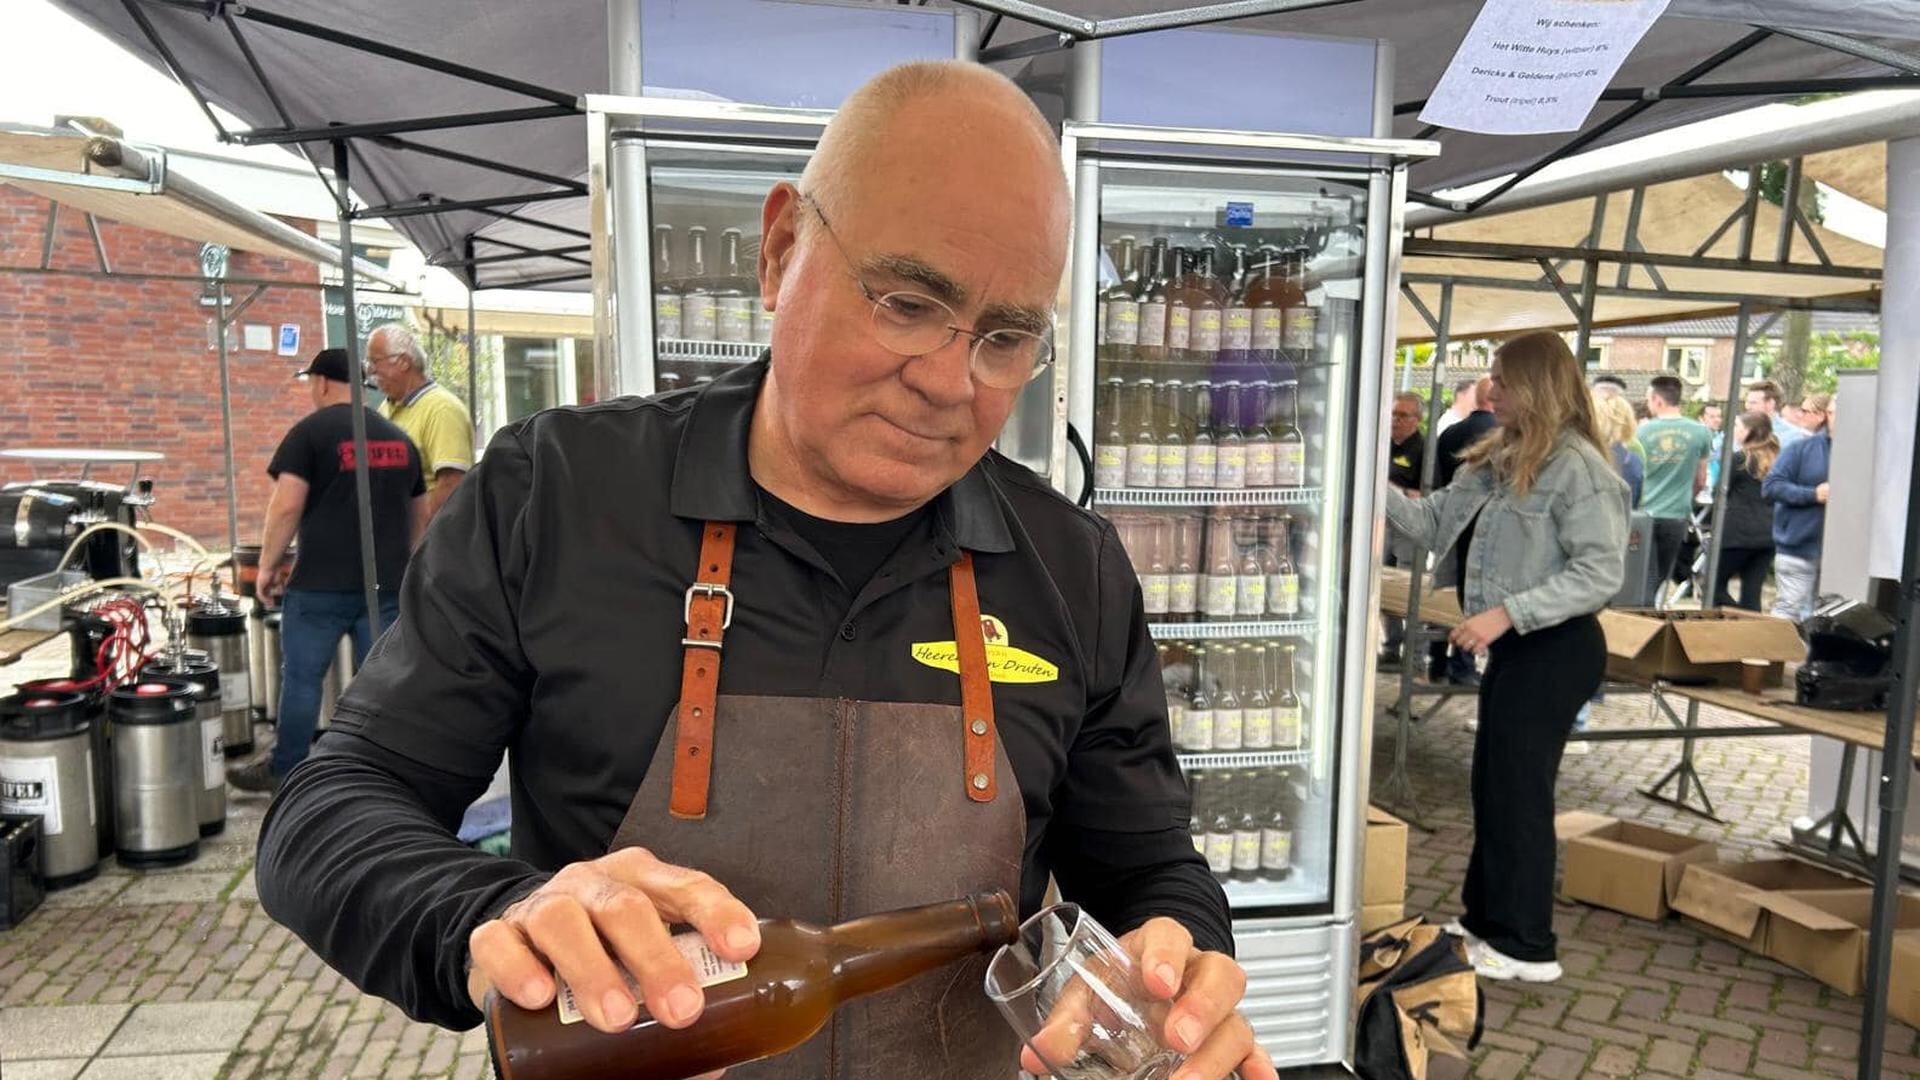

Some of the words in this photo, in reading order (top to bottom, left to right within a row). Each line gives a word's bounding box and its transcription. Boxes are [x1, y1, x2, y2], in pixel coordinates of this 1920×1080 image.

[1537, 18, 1551, 28] Wij
[1492, 41, 1509, 51] Het
[1511, 42, 1534, 52] Witte
[1536, 44, 1560, 55] Huys
[1507, 69, 1516, 78] &
[915, 646, 959, 662] Heere
[1003, 659, 1054, 678] Druten
